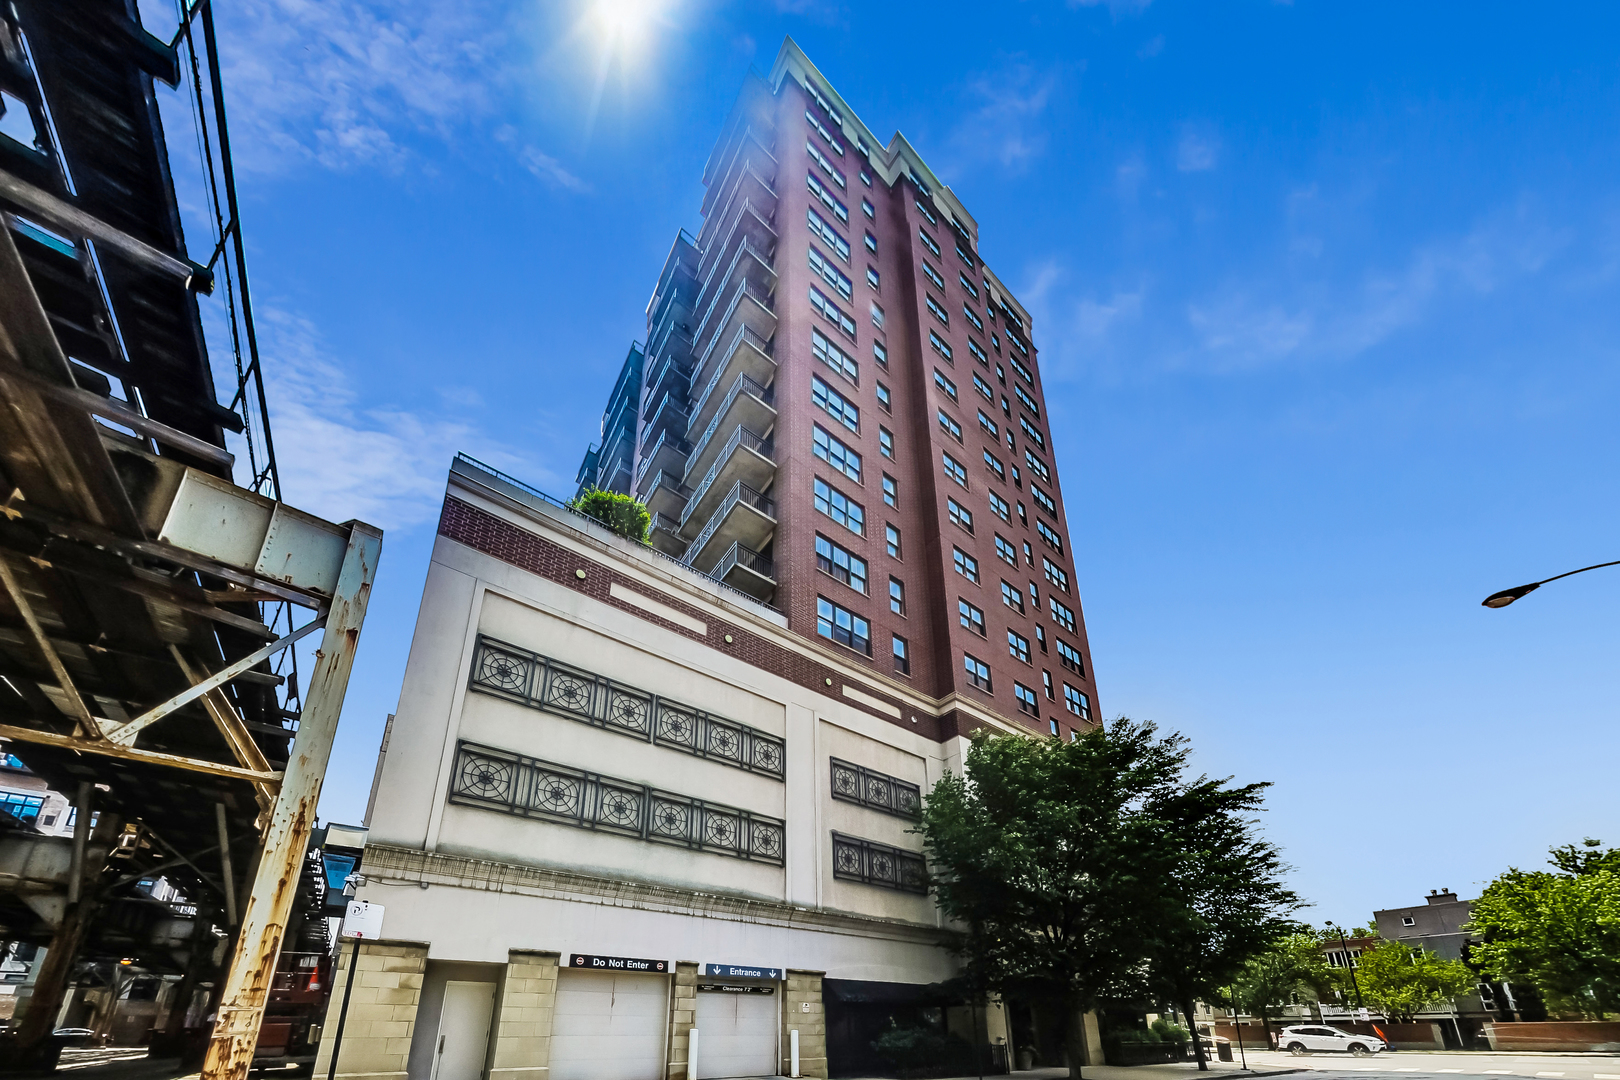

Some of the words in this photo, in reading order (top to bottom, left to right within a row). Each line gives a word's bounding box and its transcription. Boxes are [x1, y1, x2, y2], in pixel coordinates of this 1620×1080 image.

[593, 958, 606, 967] Do
[608, 959, 624, 968] Not
[626, 960, 649, 969] Enter
[730, 968, 761, 976] Entrance
